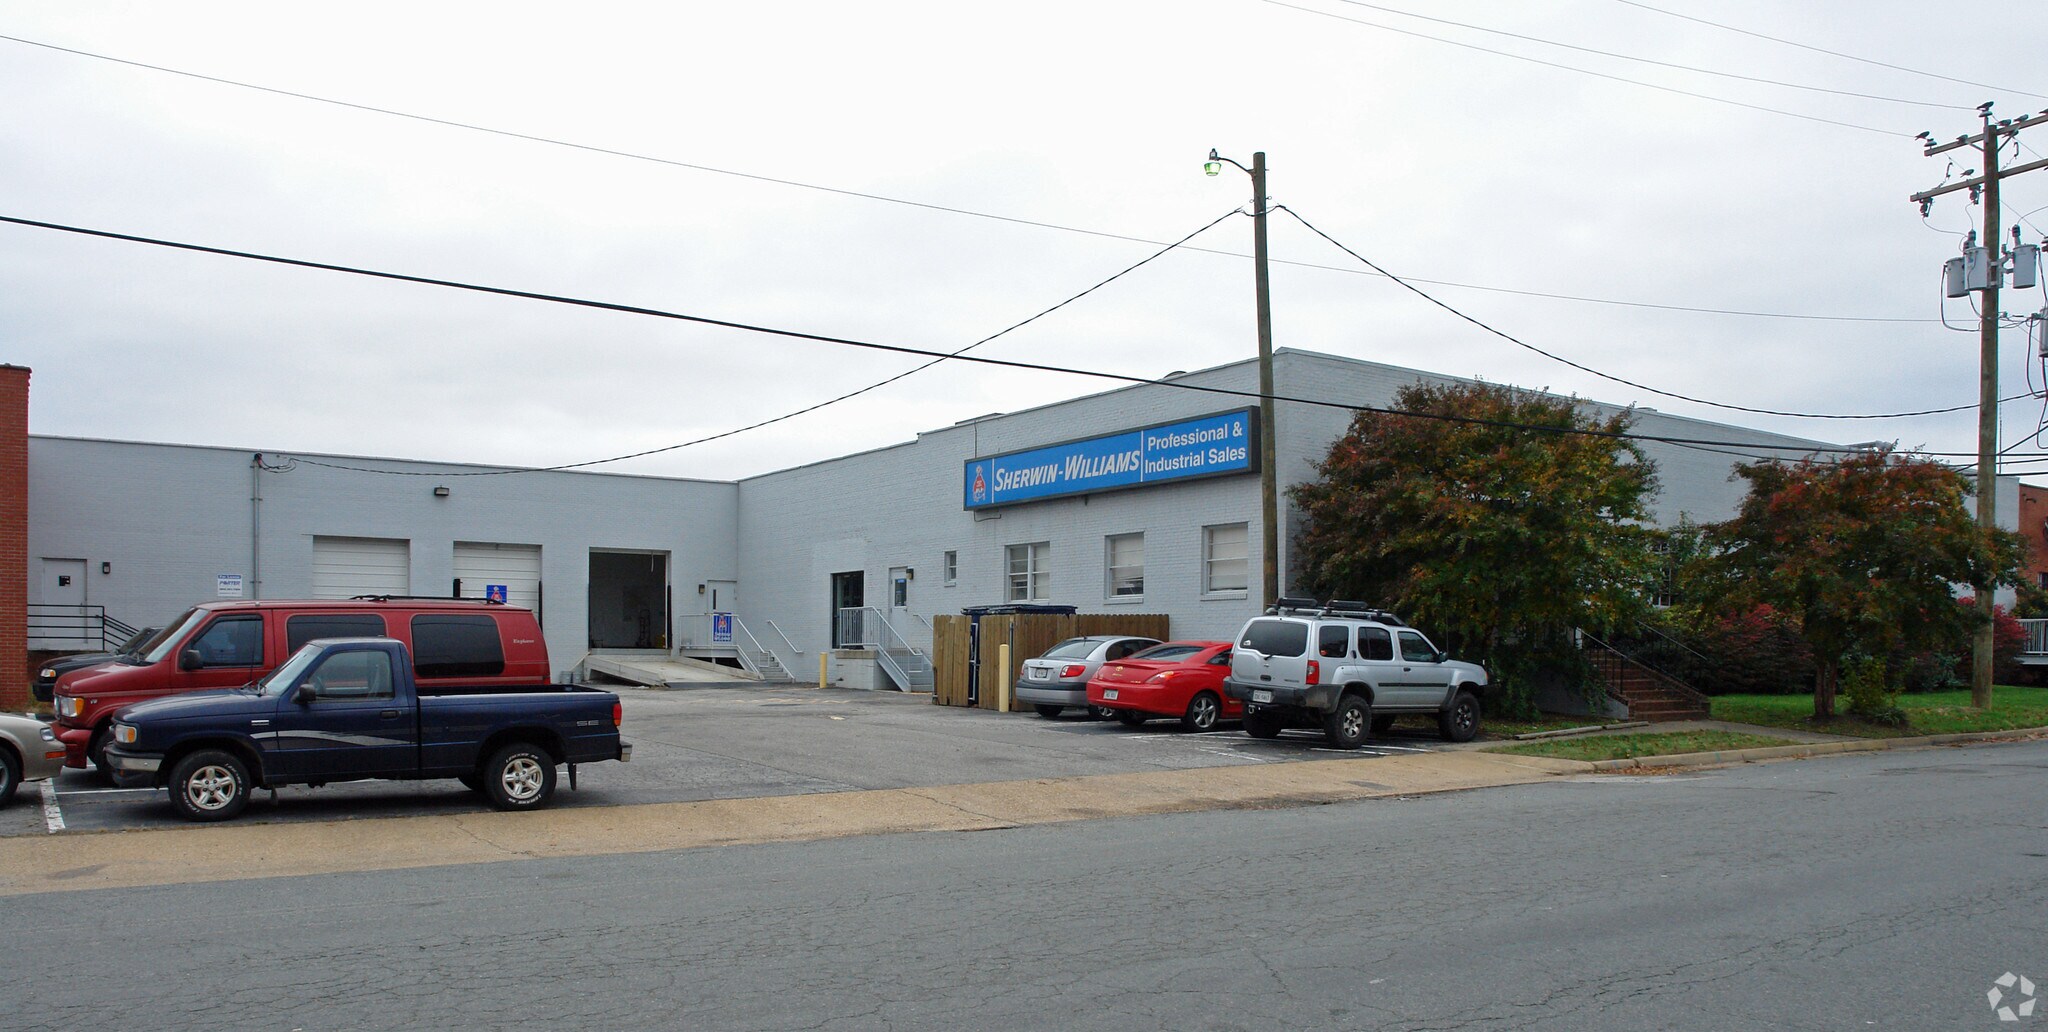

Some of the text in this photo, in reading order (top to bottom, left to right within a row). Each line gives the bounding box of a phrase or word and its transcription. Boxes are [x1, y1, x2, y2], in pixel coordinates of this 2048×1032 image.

[1147, 421, 1242, 452] Professional &
[1144, 446, 1246, 474] Industrial Sales
